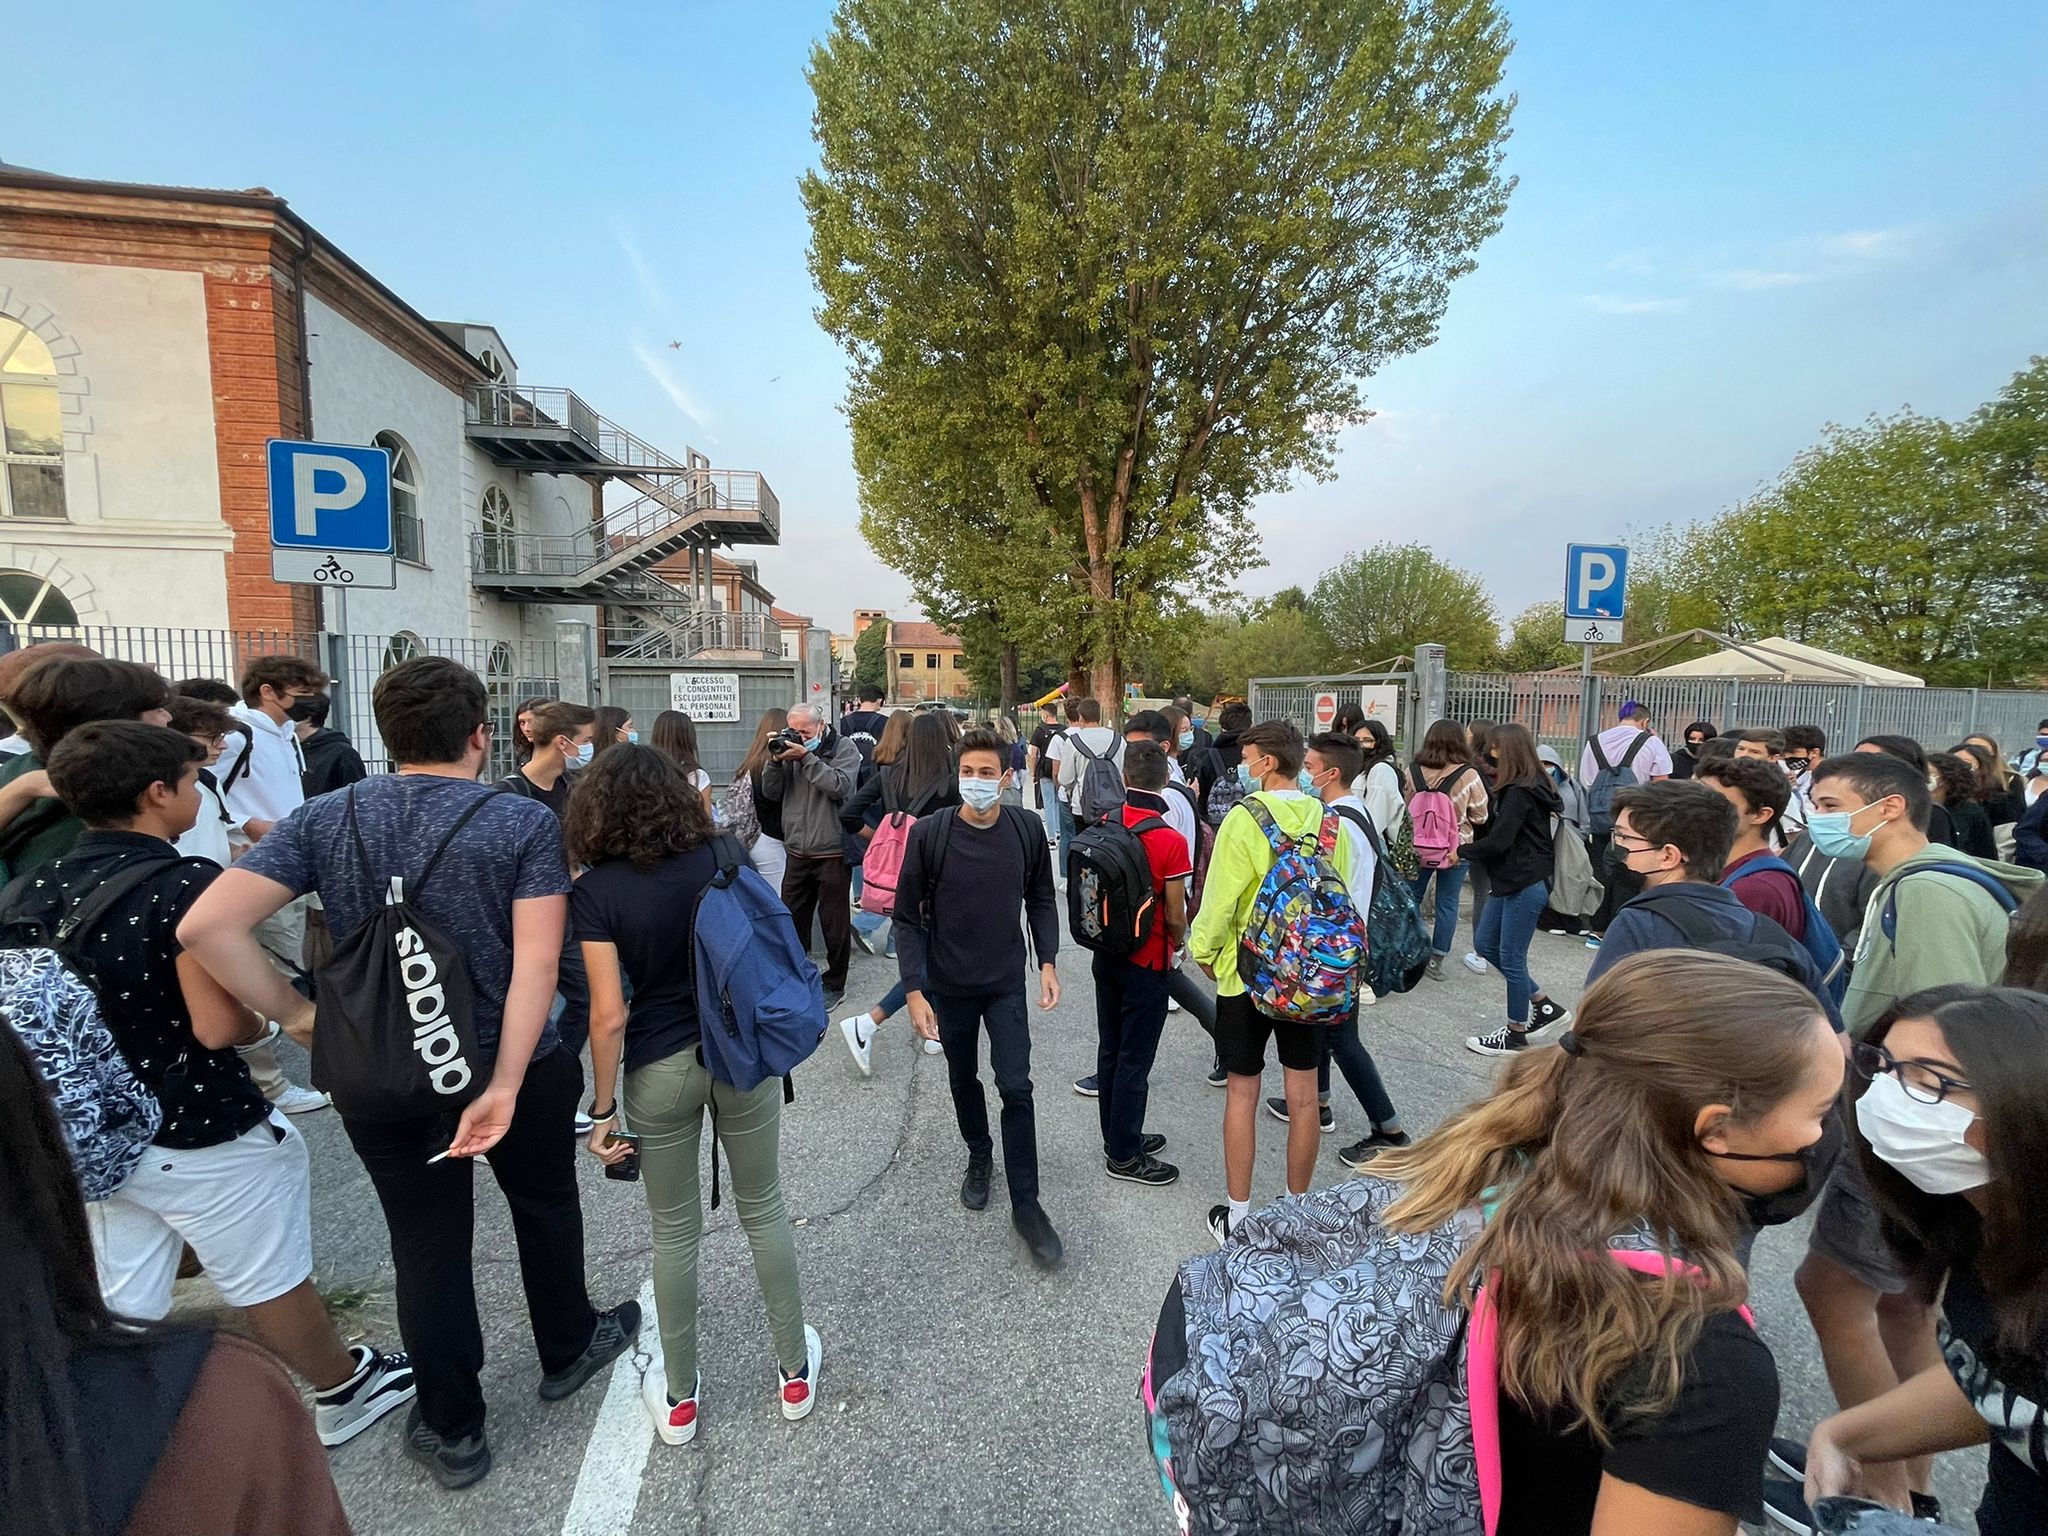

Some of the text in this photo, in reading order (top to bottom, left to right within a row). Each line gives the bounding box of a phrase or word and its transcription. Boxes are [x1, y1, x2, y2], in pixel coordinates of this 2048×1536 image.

[292, 452, 367, 537] P
[1578, 551, 1617, 610] P
[687, 685, 732, 693] CONSENTITO
[673, 693, 738, 702] ESCLUSIVAMENTE
[679, 702, 732, 710] AL PERSONALE
[704, 711, 733, 719] SUOLA
[395, 925, 473, 1096] adidas
